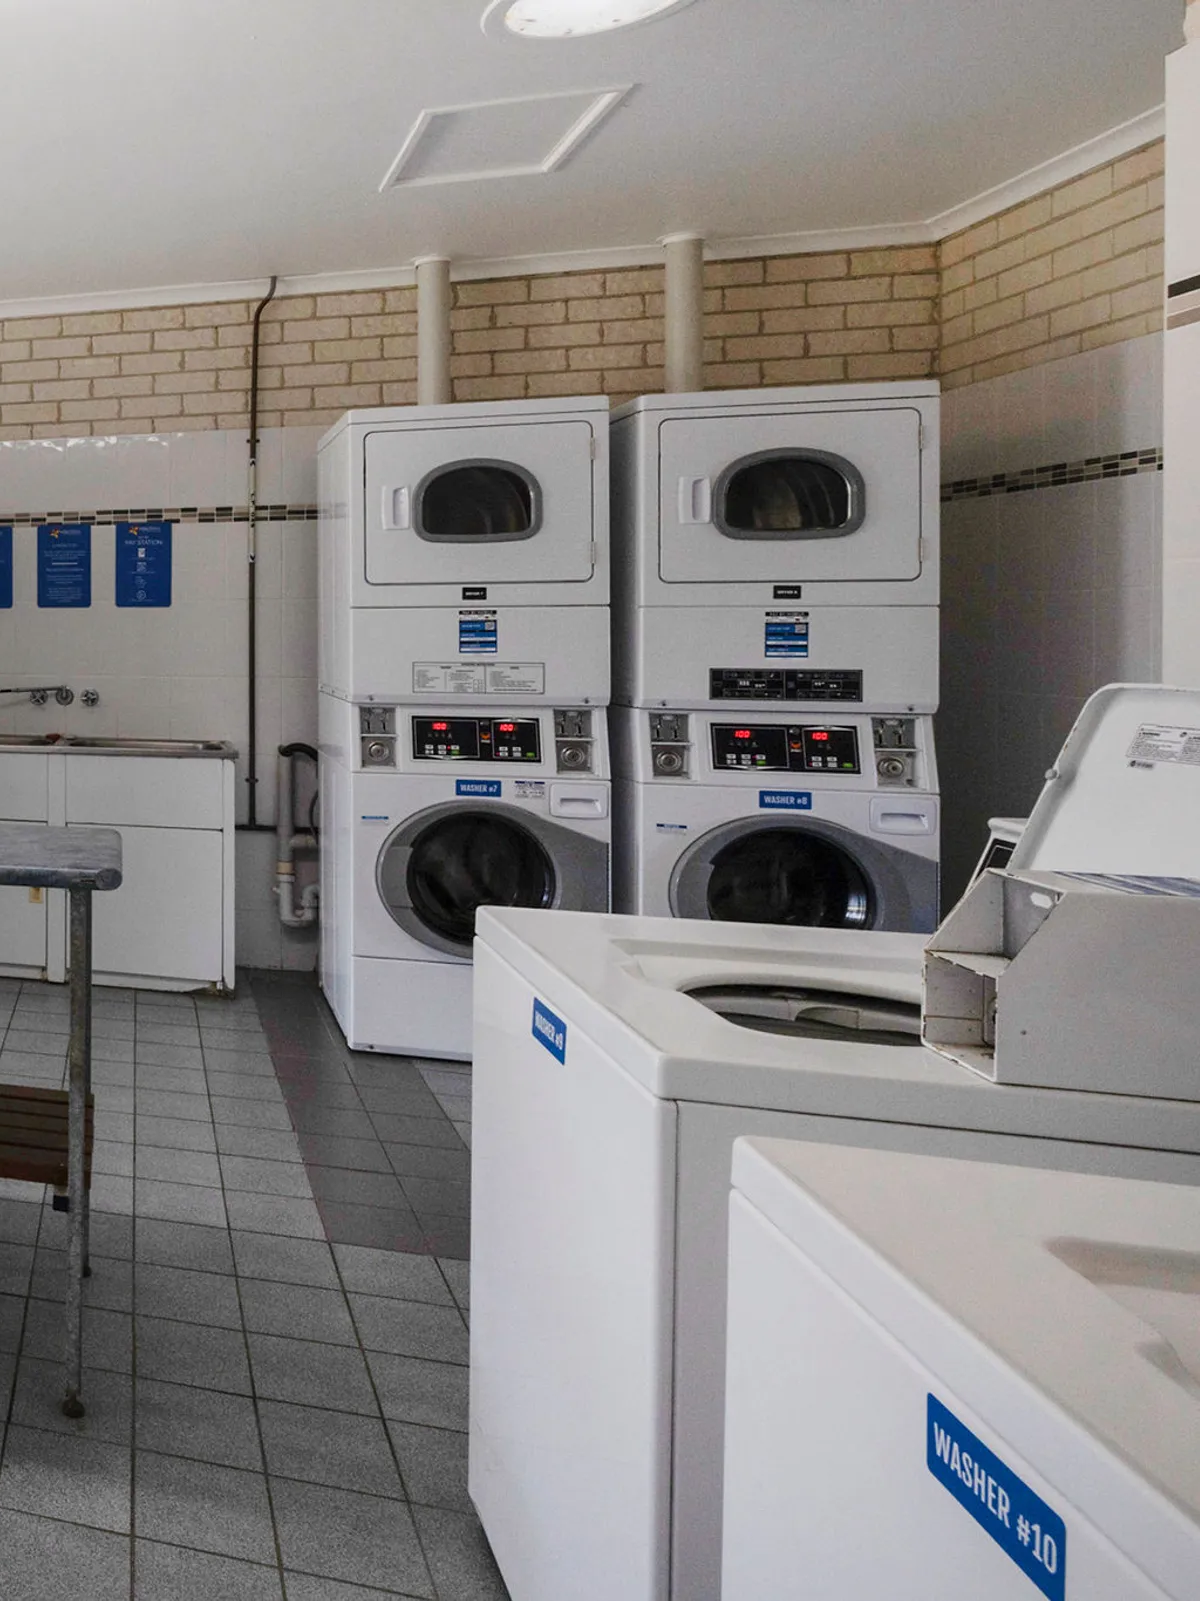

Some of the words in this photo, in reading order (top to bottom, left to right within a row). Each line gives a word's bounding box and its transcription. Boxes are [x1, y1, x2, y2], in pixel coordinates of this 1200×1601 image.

[432, 722, 447, 730] 100
[500, 723, 514, 731] 100
[734, 730, 750, 739] 100
[812, 732, 828, 741] 100
[460, 784, 487, 793] WASHER
[488, 784, 498, 793] #7
[763, 795, 795, 804] WASHER
[796, 796, 808, 805] #8
[535, 1010, 555, 1044] WASHER
[933, 1421, 1011, 1529] WASHER
[1016, 1514, 1057, 1574] #10
